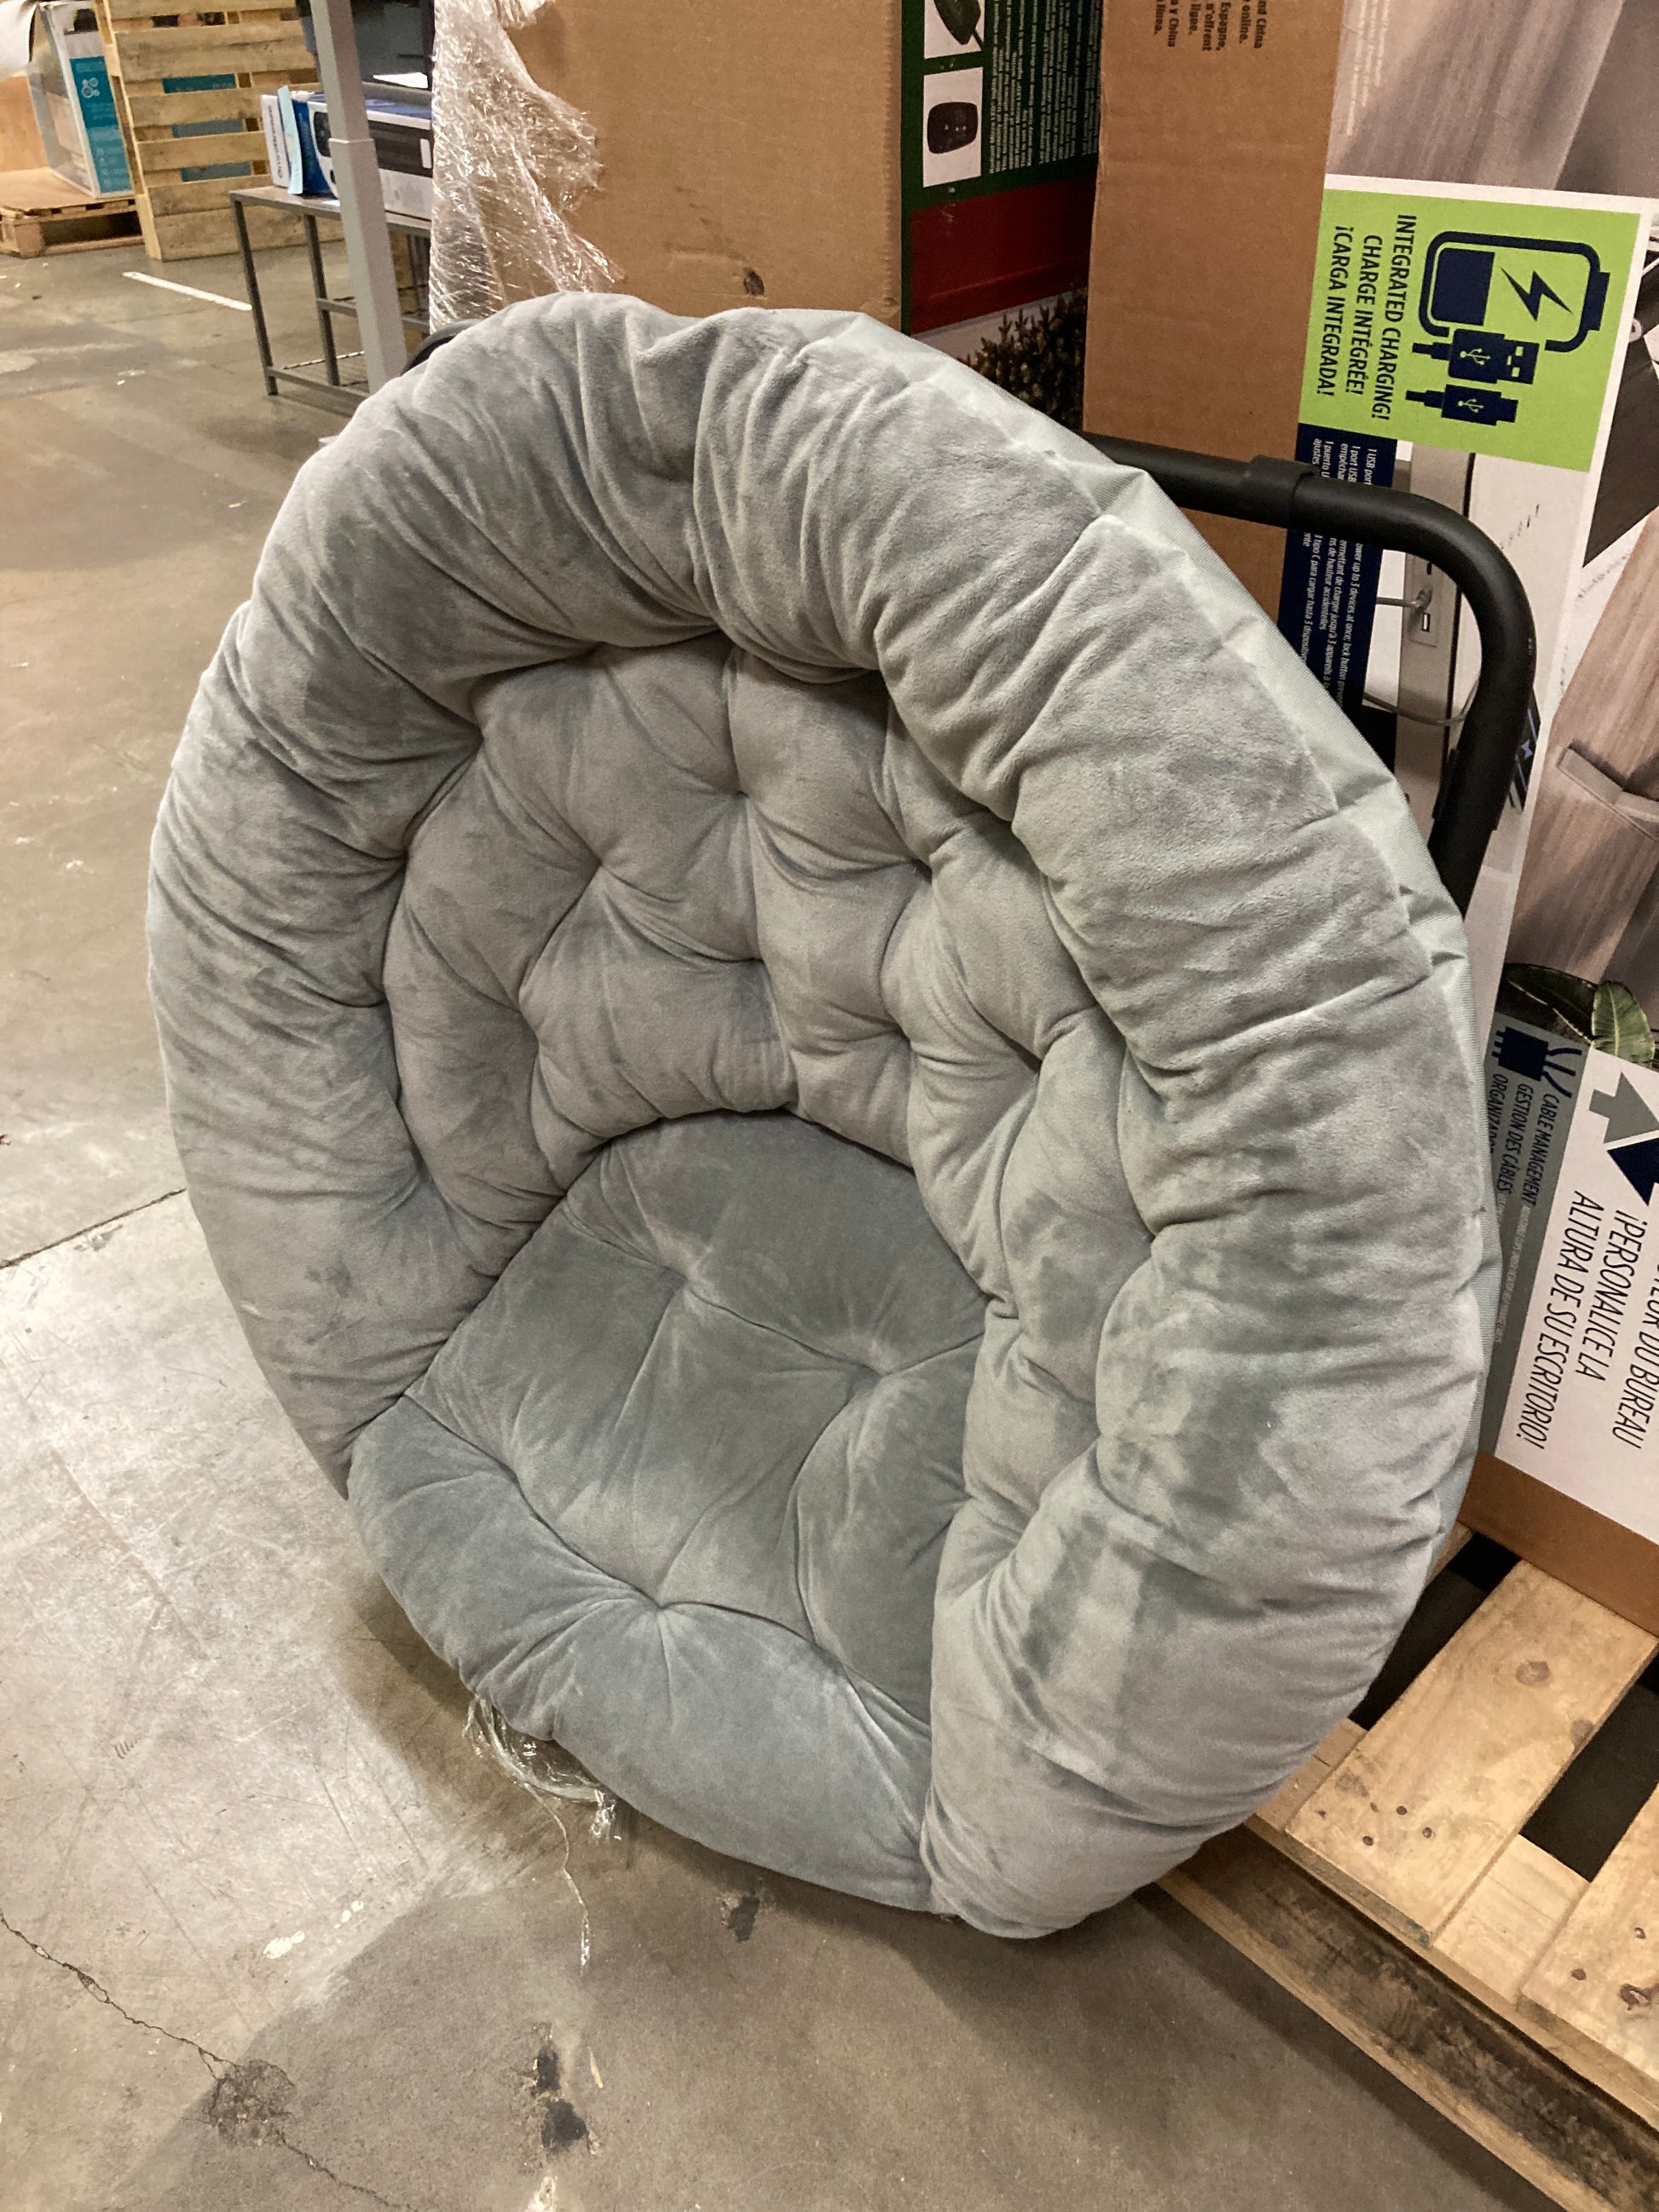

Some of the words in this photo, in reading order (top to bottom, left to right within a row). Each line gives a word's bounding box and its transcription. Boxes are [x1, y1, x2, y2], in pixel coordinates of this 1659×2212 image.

[1168, 18, 1179, 47] China
[1216, 2, 1231, 51] Espagne,
[1240, 5, 1251, 43] online.
[1254, 19, 1266, 49] China
[1329, 226, 1354, 290] ¡CARGA
[1356, 235, 1383, 305] CHARGE
[1385, 215, 1417, 322] INTEGRATED
[1317, 297, 1345, 396] INTEGRADA!
[1345, 309, 1373, 395] INTÉGRÉE!
[1372, 328, 1401, 420] CHARGING!
[1312, 439, 1321, 465] ajustes
[1322, 445, 1332, 470] puerto
[1350, 450, 1358, 465] port
[1366, 453, 1376, 469] USB
[1312, 539, 1321, 553] tipo
[1328, 547, 1336, 557] de
[1337, 540, 1347, 575] ermettant
[1354, 543, 1363, 561] ower
[1309, 561, 1319, 576] para
[1325, 558, 1336, 586] hauteur
[1335, 576, 1344, 586] de
[1352, 563, 1361, 572] up
[1307, 577, 1316, 600] cargar
[1332, 586, 1342, 612] charger
[1347, 588, 1359, 613] devices
[1304, 600, 1315, 619] hasta
[1319, 586, 1331, 630] accidentelles
[1323, 644, 1334, 675] appareils
[1342, 643, 1351, 656] lock
[1338, 657, 1350, 679] button
[1509, 1084, 1534, 1132] GESTION
[1537, 1094, 1559, 1130] CABLE
[1505, 1130, 1523, 1154] DES
[1496, 1154, 1519, 1194] CÂBLES
[1521, 1129, 1552, 1206] MANAGEMENT
[1558, 1191, 1604, 1273] ALTURA
[1551, 1273, 1584, 1308] DE
[1582, 1210, 1647, 1357] ¡PERSONALICE
[1544, 1303, 1576, 1337] SU
[1575, 1353, 1609, 1381] LA
[1517, 1333, 1569, 1450] ESCRITORIO!
[1613, 1364, 1659, 1449] BUREAU
